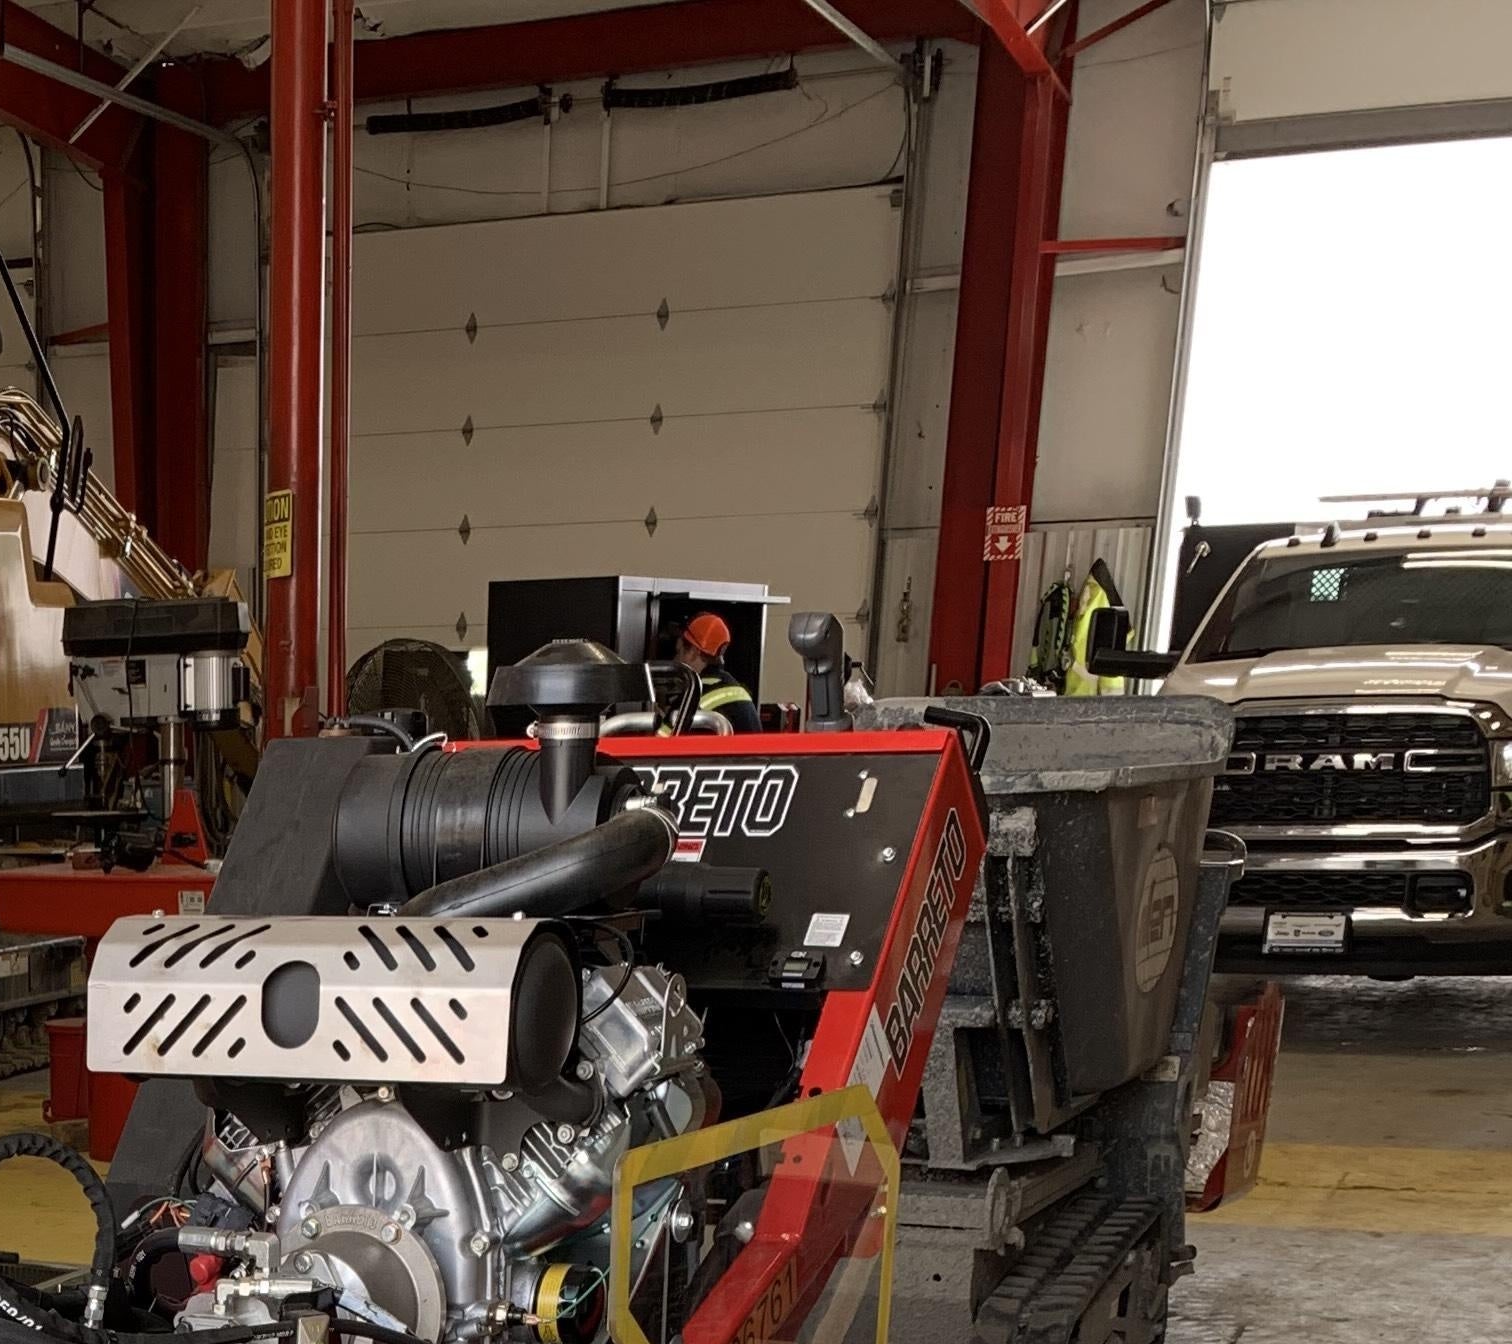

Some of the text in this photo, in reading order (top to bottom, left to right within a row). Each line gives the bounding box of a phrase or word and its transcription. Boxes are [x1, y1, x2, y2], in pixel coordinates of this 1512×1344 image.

[994, 512, 1018, 524] FIRE
[274, 525, 289, 539] EYE
[1264, 752, 1395, 771] RAM
[883, 808, 967, 1081] BARRETO
